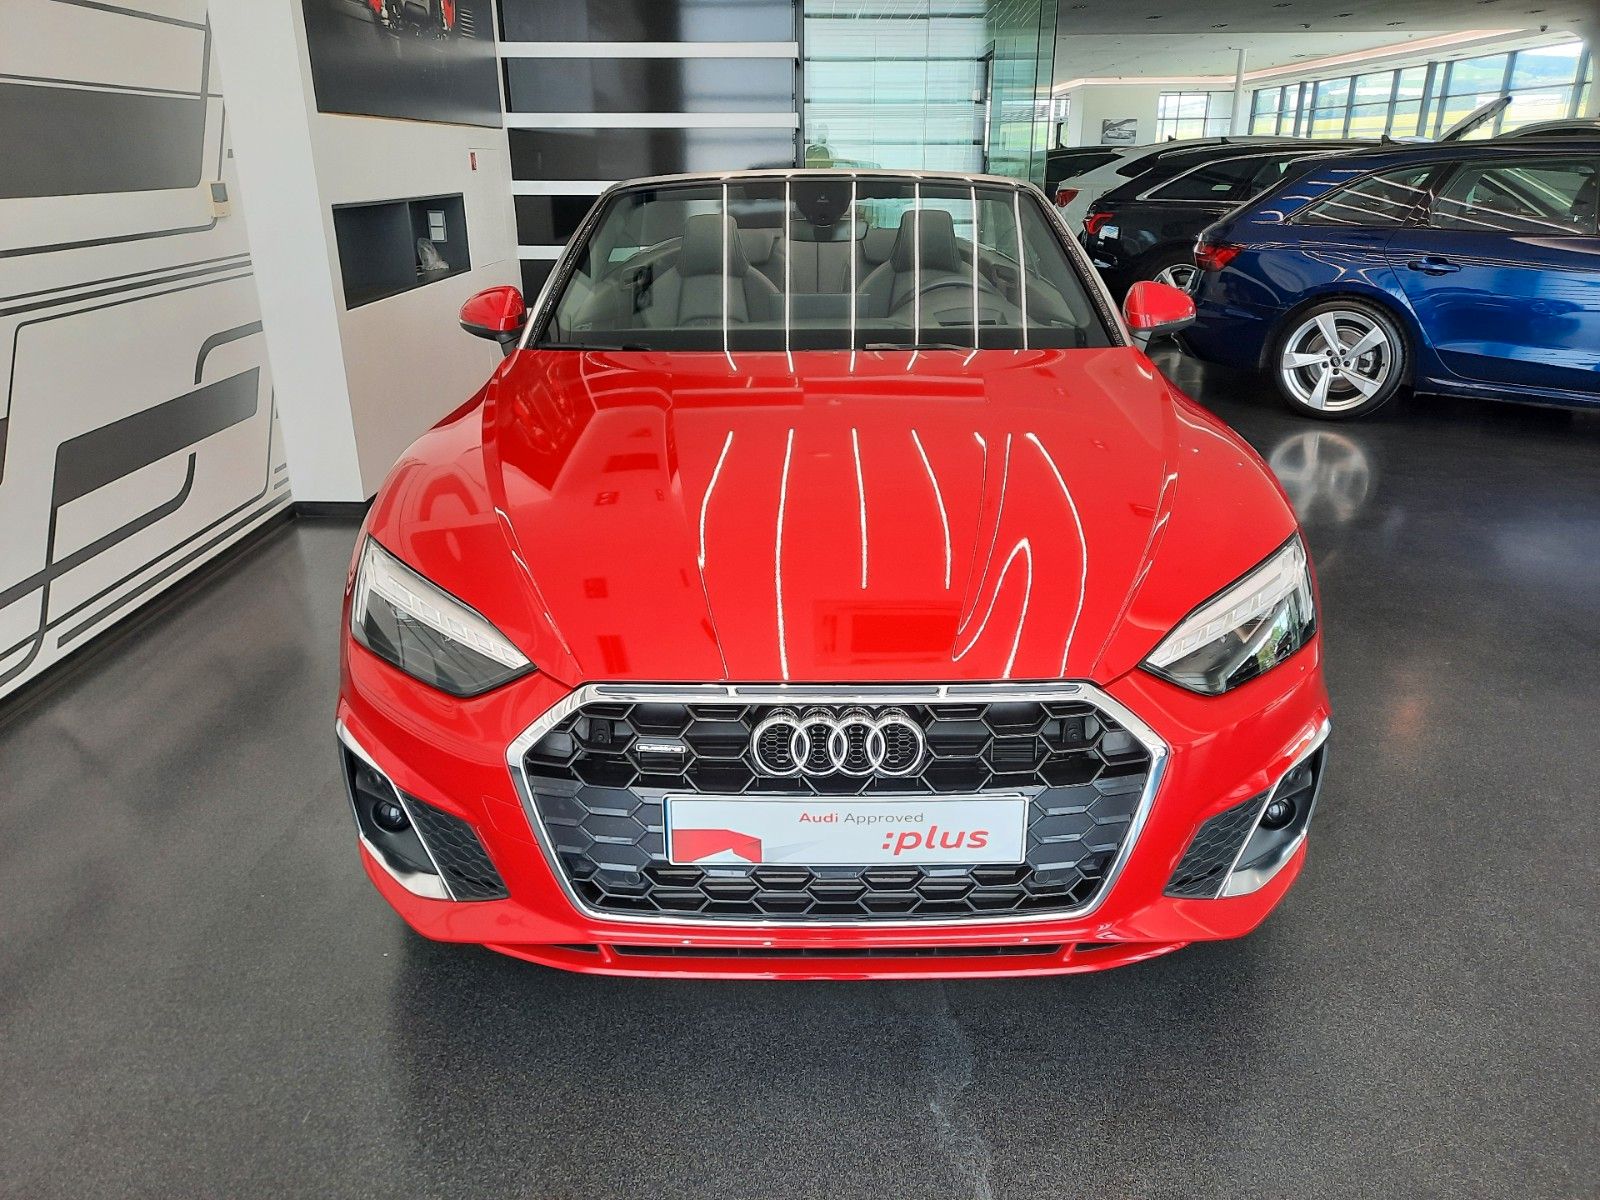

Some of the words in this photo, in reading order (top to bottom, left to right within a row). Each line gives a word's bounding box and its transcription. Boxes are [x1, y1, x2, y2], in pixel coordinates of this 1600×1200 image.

[799, 813, 838, 823] Audi
[844, 813, 924, 825] Approved
[882, 826, 989, 855] :plus
